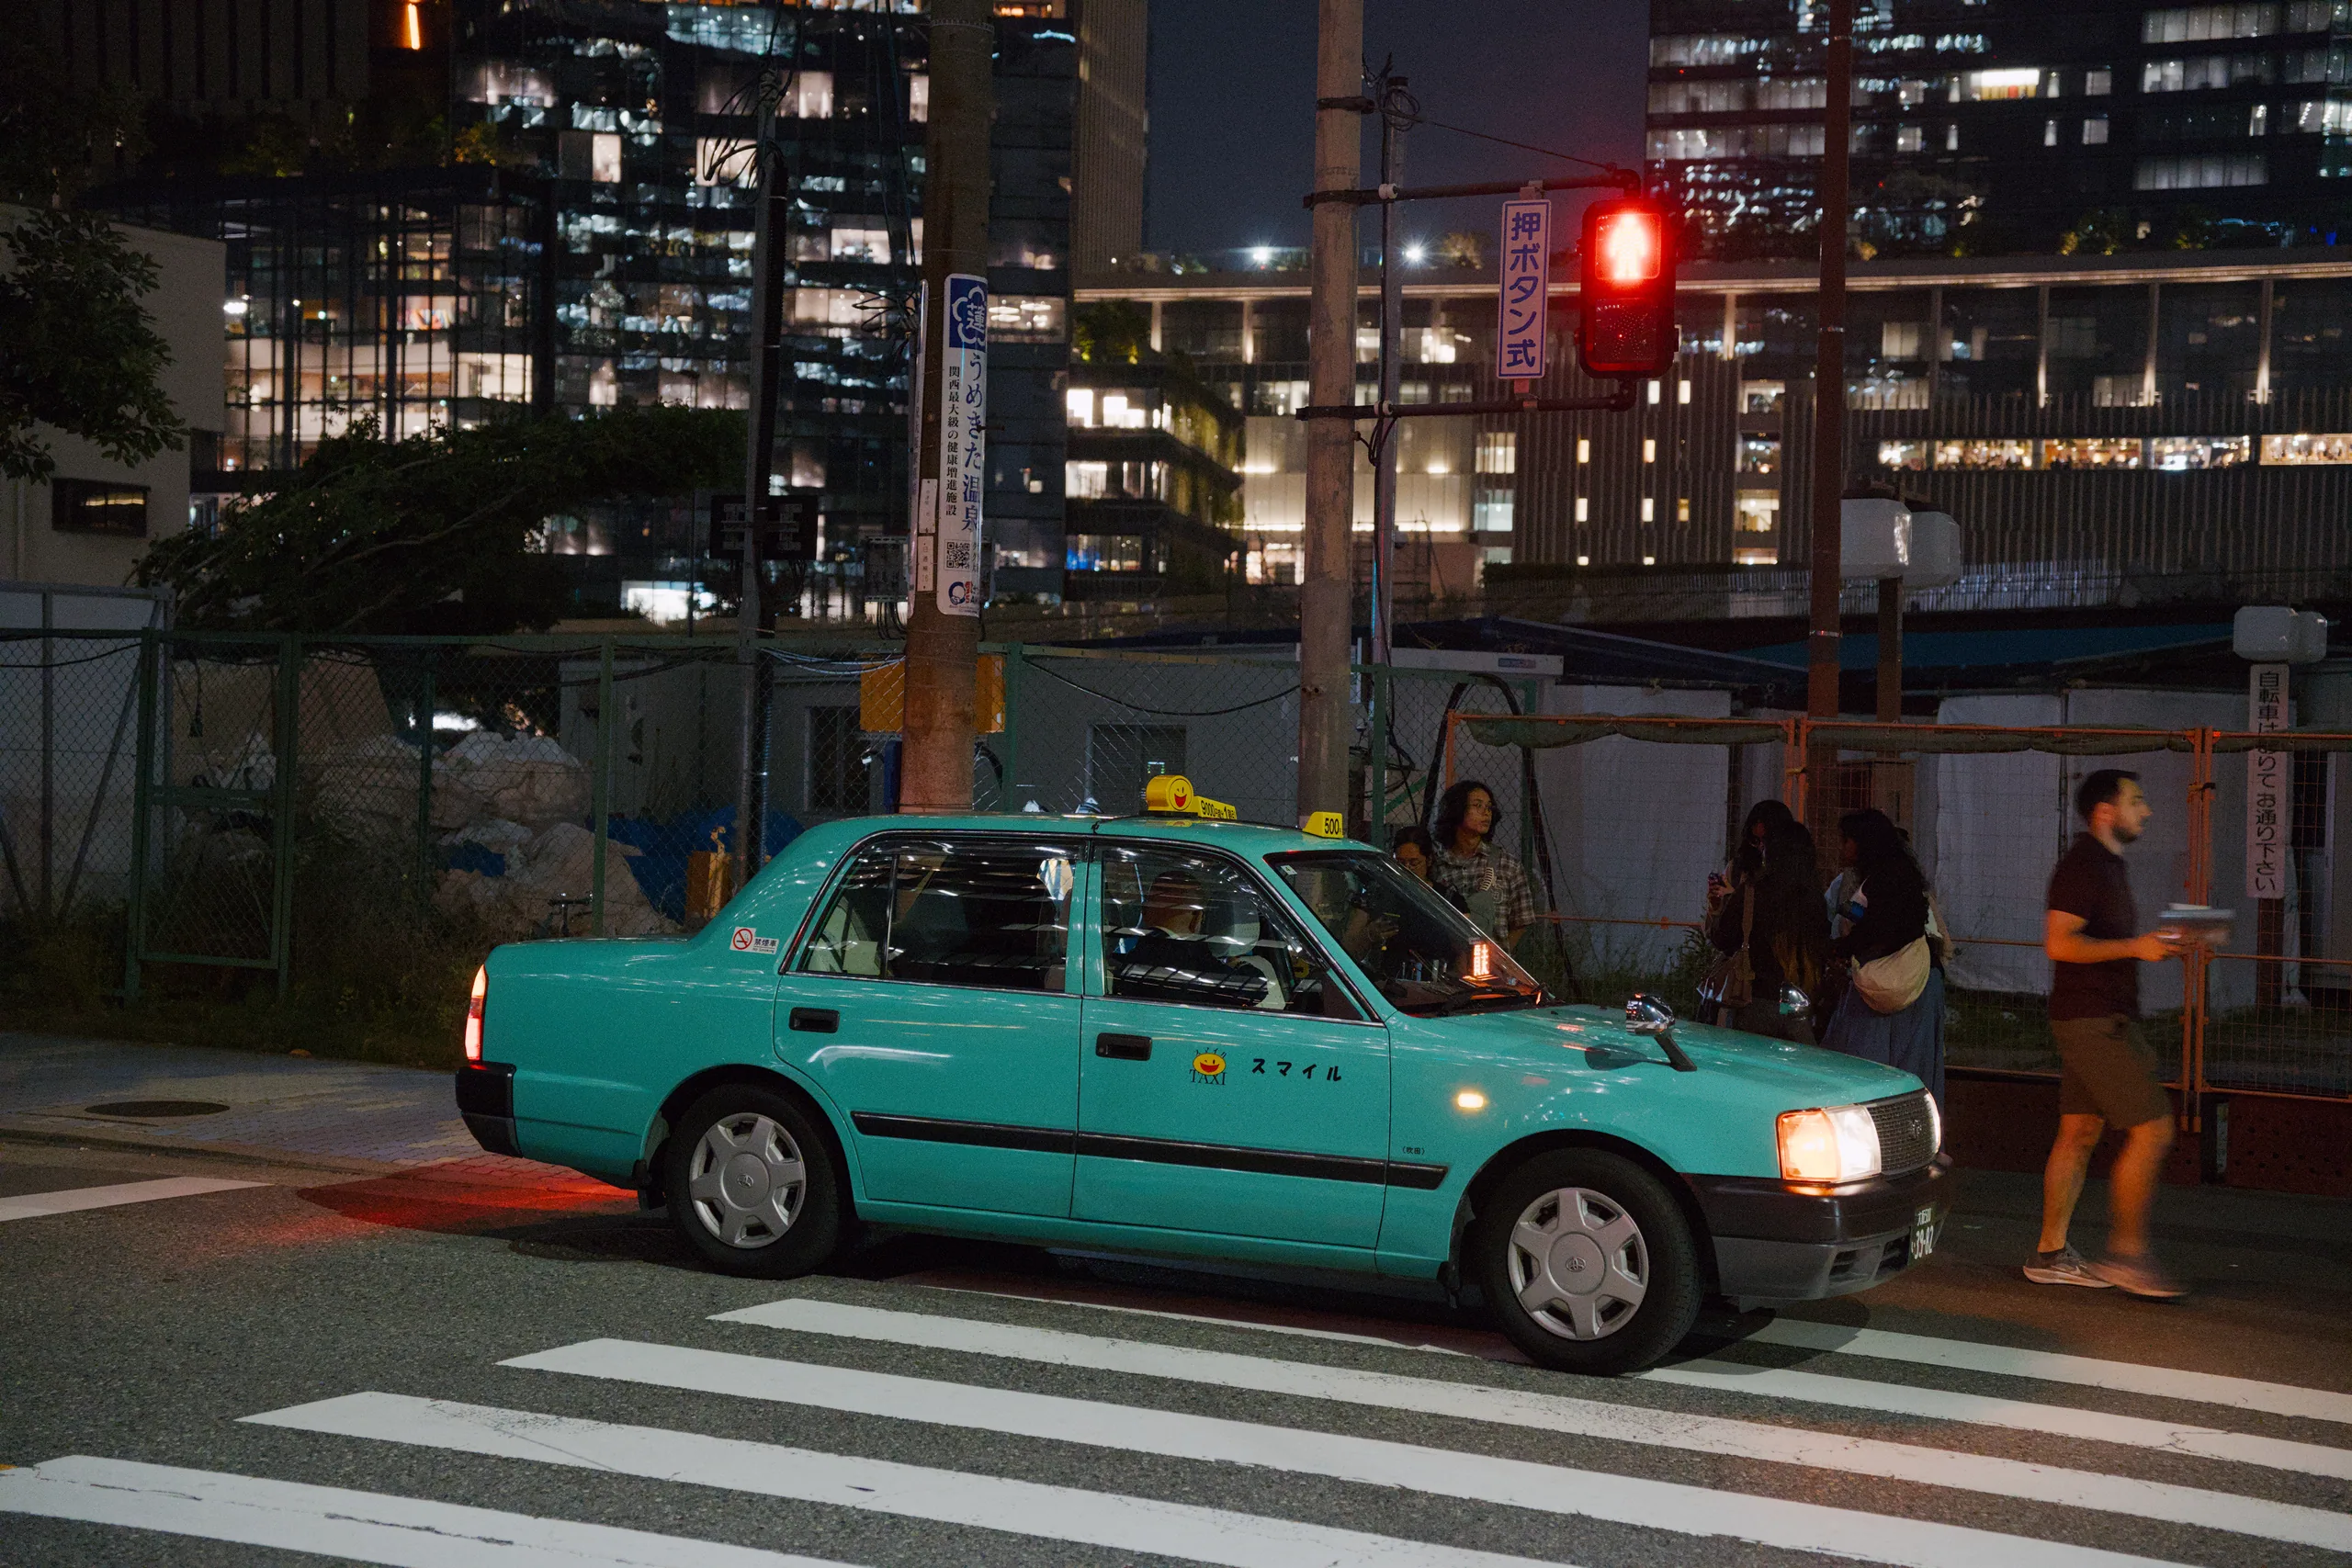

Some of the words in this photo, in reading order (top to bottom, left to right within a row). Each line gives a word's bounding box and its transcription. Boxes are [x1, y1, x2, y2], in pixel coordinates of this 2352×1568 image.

[1507, 212, 1541, 367] 押ボタン式
[945, 366, 960, 516] 関西最大級の健康増進施設
[962, 352, 982, 532] うめきた温泉
[1189, 1069, 1227, 1086] TAXI
[1252, 1058, 1341, 1082] スマイル
